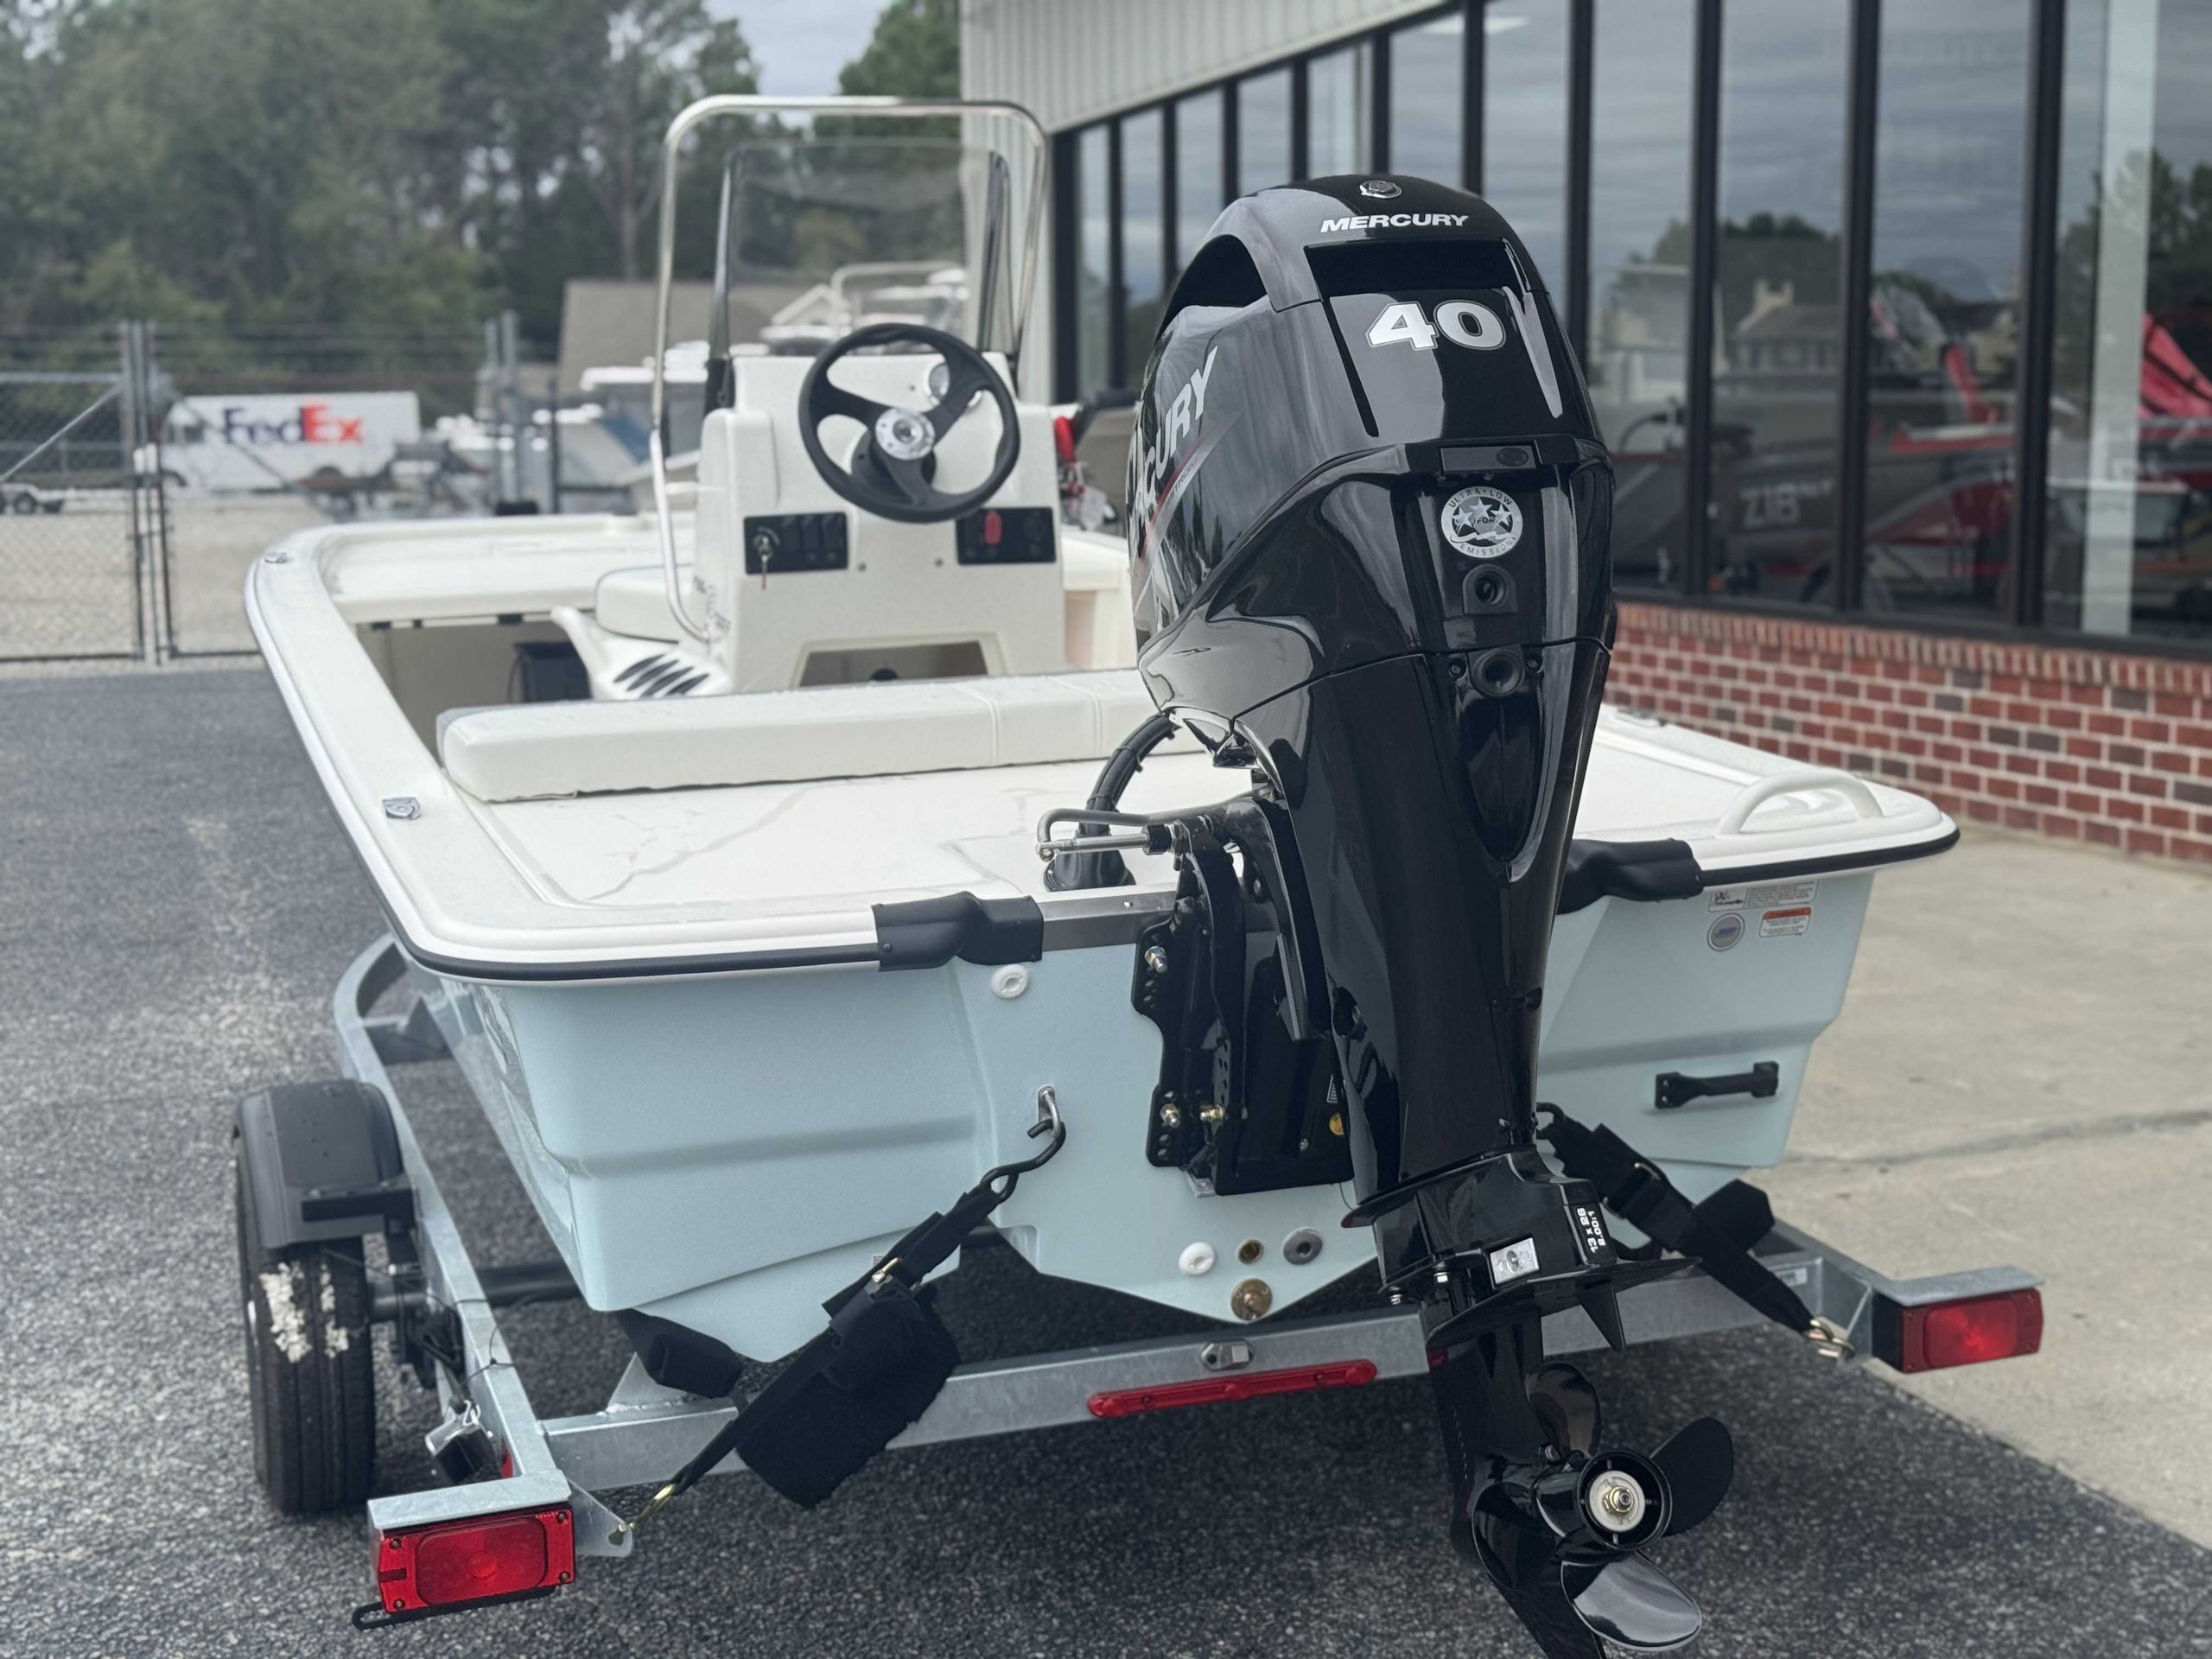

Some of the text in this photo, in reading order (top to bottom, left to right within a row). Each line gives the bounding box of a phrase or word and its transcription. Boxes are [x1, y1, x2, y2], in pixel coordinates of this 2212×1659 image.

[1319, 213, 1469, 233] MERCURY
[1365, 299, 1507, 351] 40
[224, 404, 364, 445] FedEx
[1448, 487, 1514, 508] ULTRA LOW
[1587, 1237, 1599, 1253] 13
